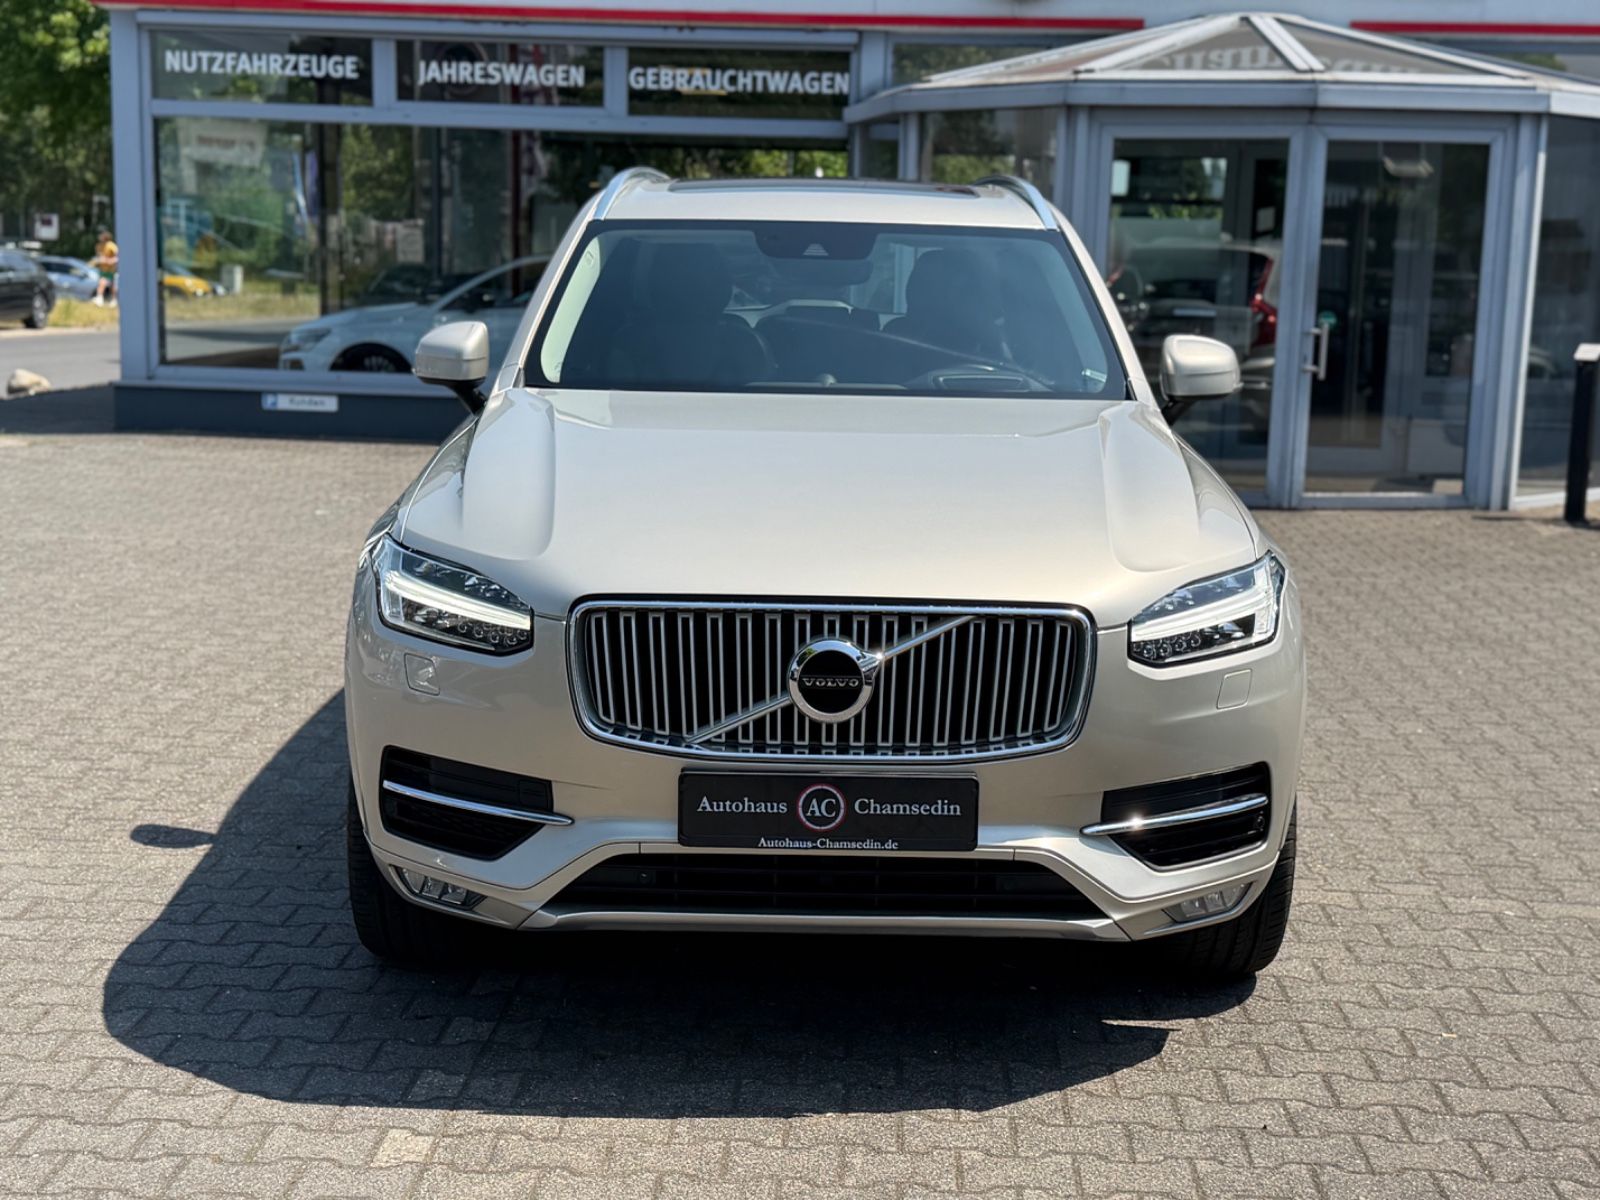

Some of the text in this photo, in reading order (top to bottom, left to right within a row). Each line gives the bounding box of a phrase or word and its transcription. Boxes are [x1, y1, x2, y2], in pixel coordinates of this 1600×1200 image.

[164, 50, 360, 80] NUTZFAHRZEUGE
[417, 60, 586, 88] JAHRESWAGEN
[628, 66, 849, 95] GEBRAUCHTWAGEN
[802, 678, 859, 687] VOLVO
[697, 796, 962, 818] Autohaus AC Chamsedin
[758, 837, 899, 850] Autohaus-Chamsedin.de
